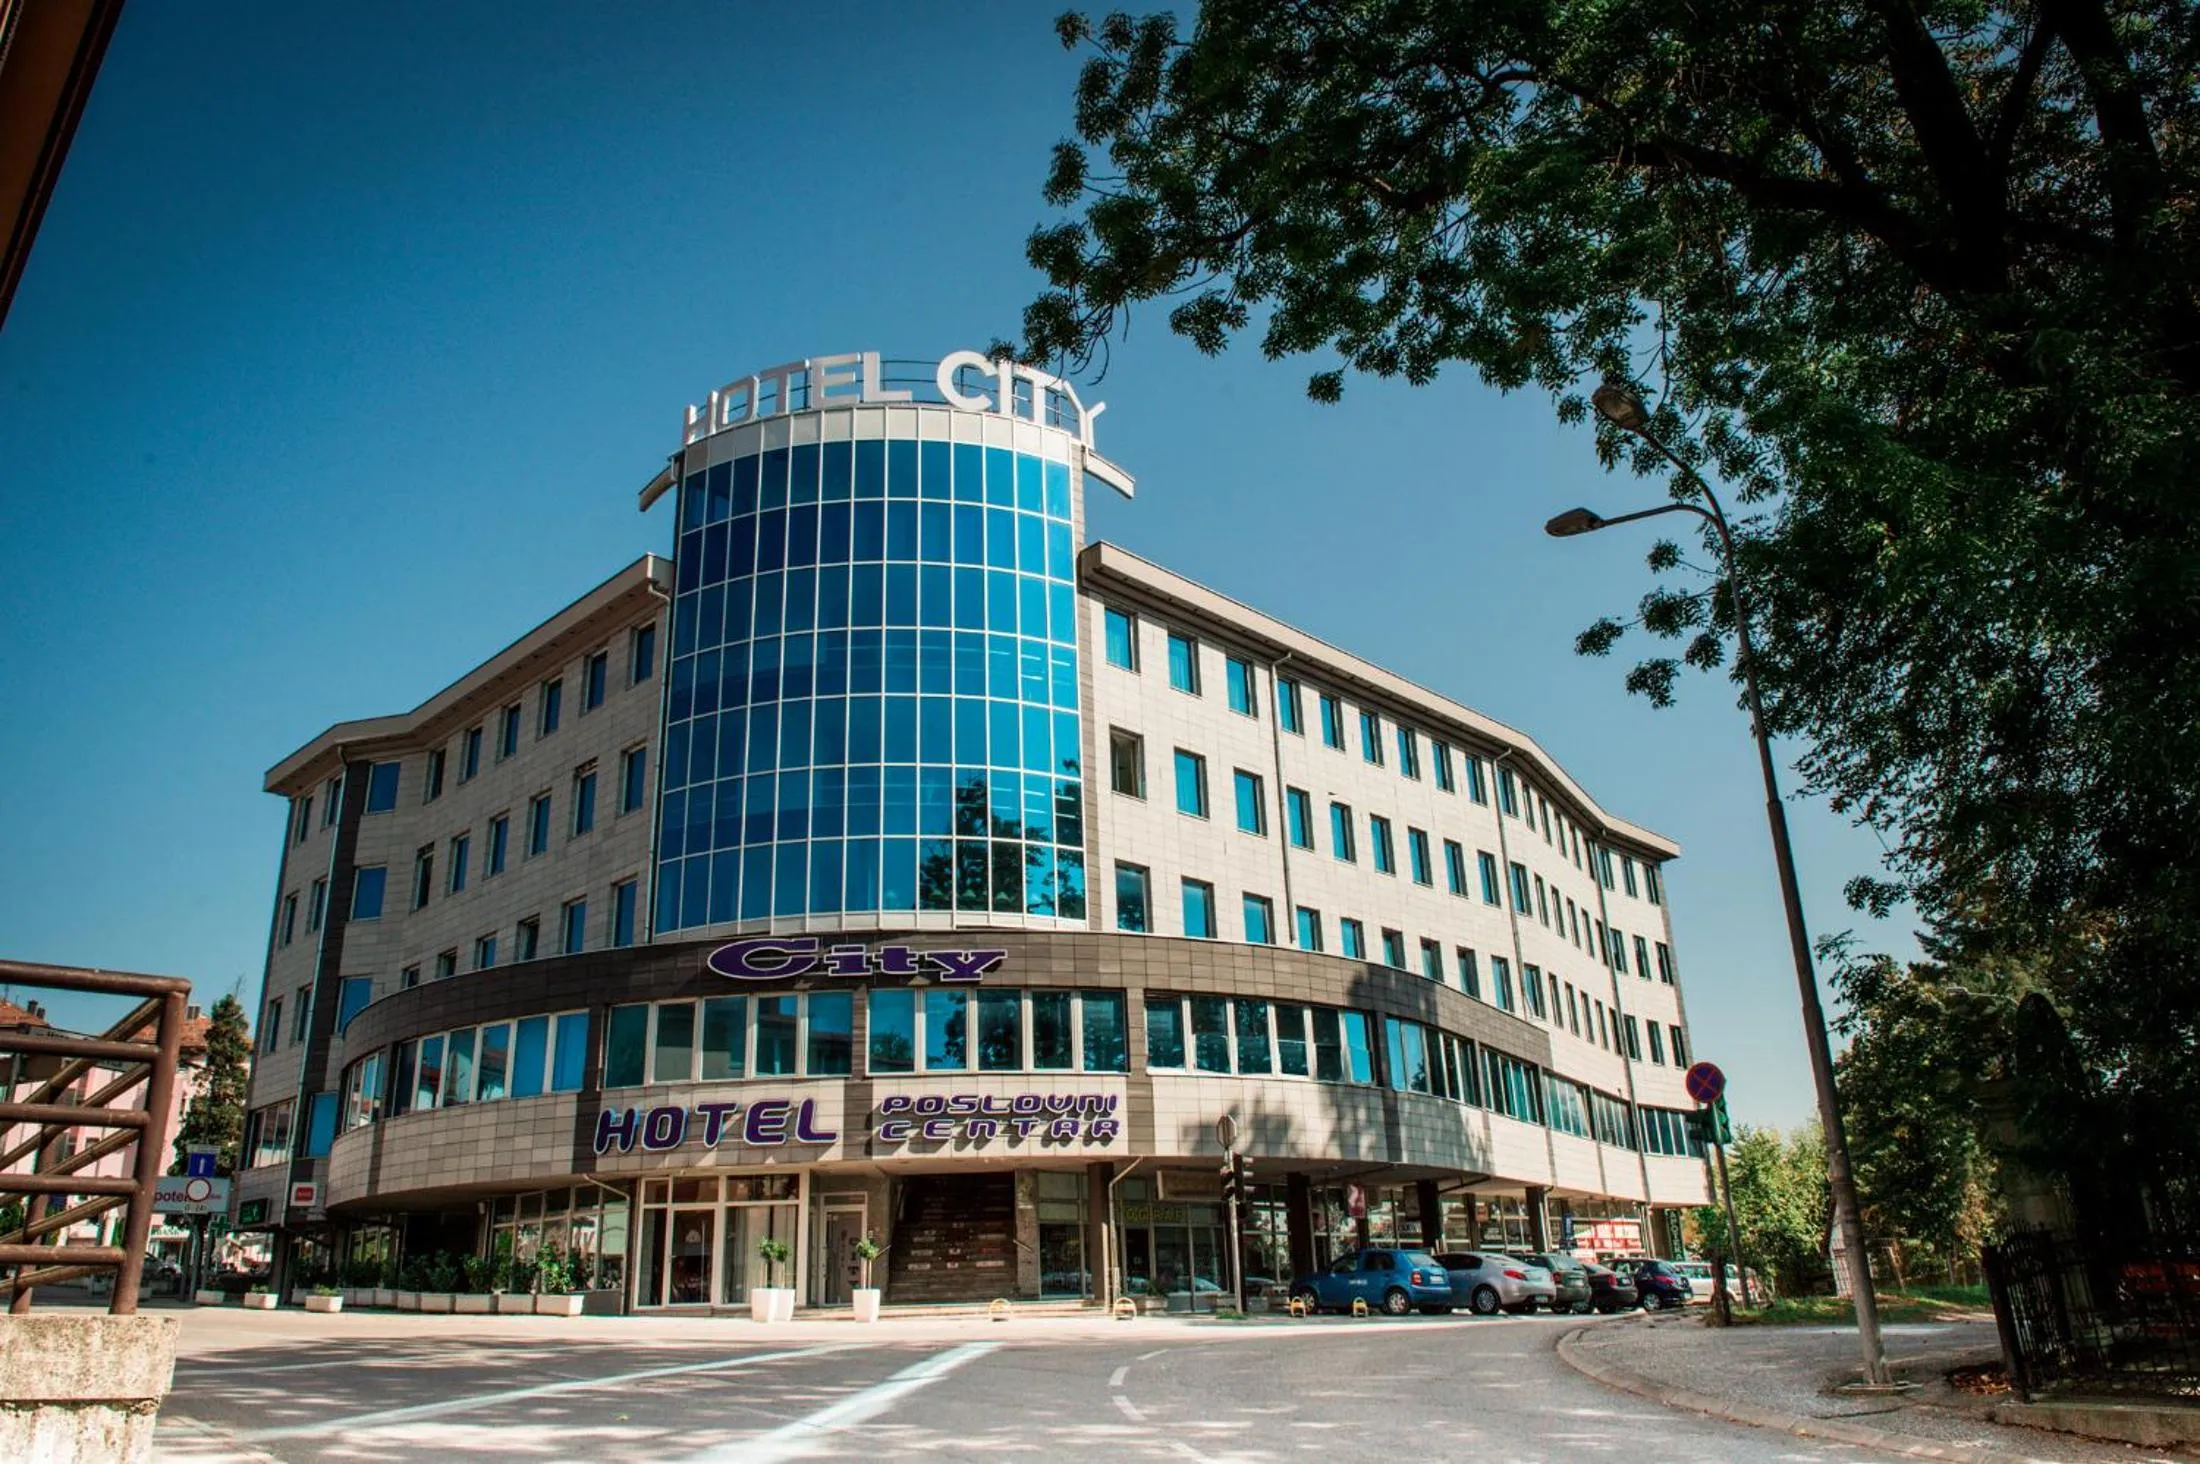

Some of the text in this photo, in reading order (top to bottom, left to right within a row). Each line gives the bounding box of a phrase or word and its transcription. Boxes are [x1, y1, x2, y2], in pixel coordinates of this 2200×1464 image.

[682, 350, 1106, 450] HOTEL CITY
[706, 937, 1008, 982] City
[594, 1097, 840, 1156] HOTEL
[880, 1094, 1119, 1117] POSLOVNI
[879, 1118, 1121, 1142] CENTAR
